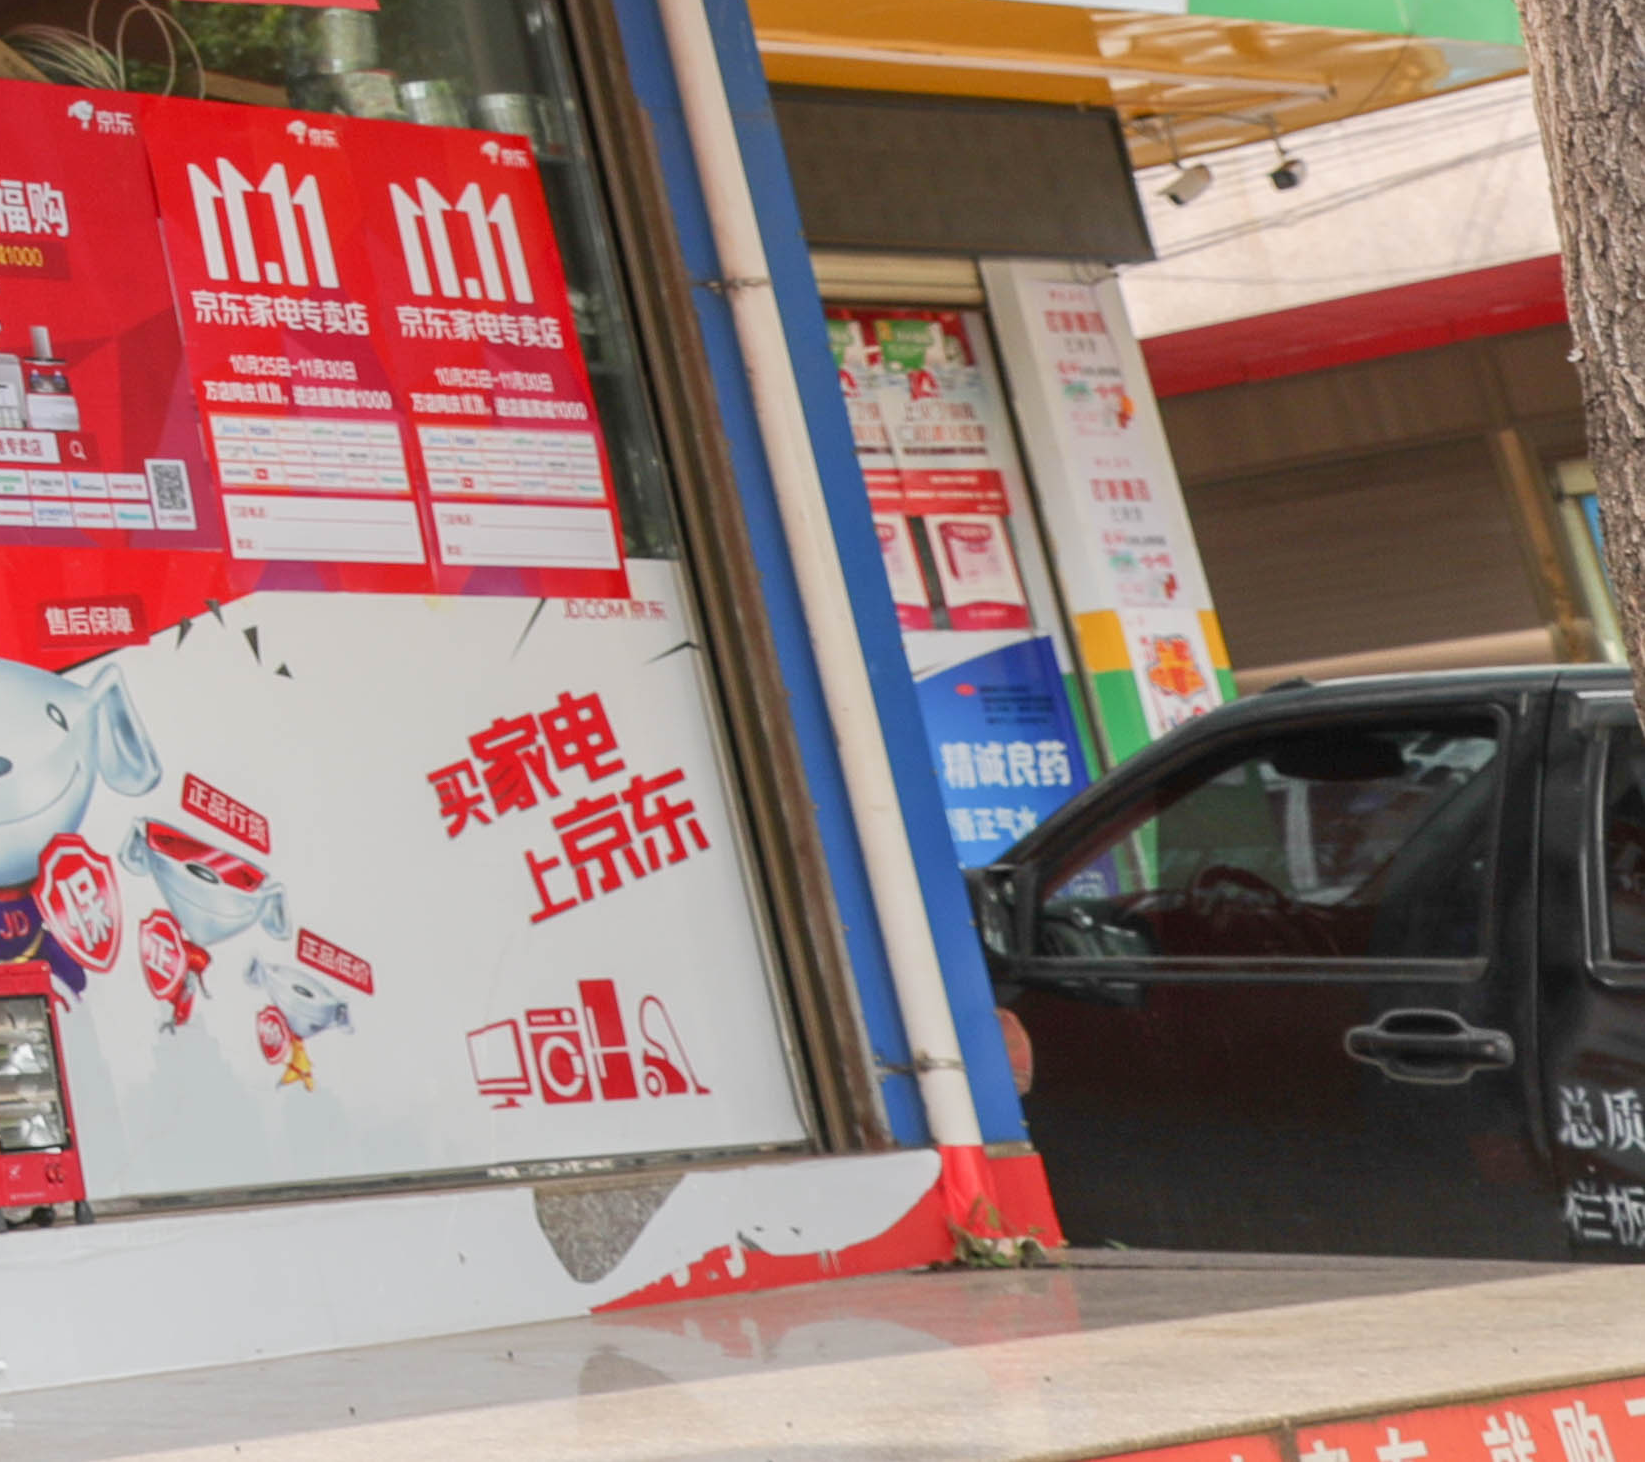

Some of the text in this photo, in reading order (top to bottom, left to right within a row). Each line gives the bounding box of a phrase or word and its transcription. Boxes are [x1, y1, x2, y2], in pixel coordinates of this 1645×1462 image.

[94, 109, 136, 136] 京东
[308, 129, 340, 148] 京东
[500, 149, 530, 168] 京东
[187, 157, 341, 289] 11.11
[388, 176, 535, 304] 11.11
[191, 289, 370, 338] 京东家电专卖店
[395, 304, 565, 351] 京东家电专卖店
[44, 607, 135, 637] 售后保障
[424, 690, 627, 842] 买家电
[188, 781, 268, 843] 正品行货
[523, 766, 713, 926] 上京东
[70, 867, 113, 953] 保
[147, 938, 176, 982] 正
[300, 935, 372, 987] 正品低价
